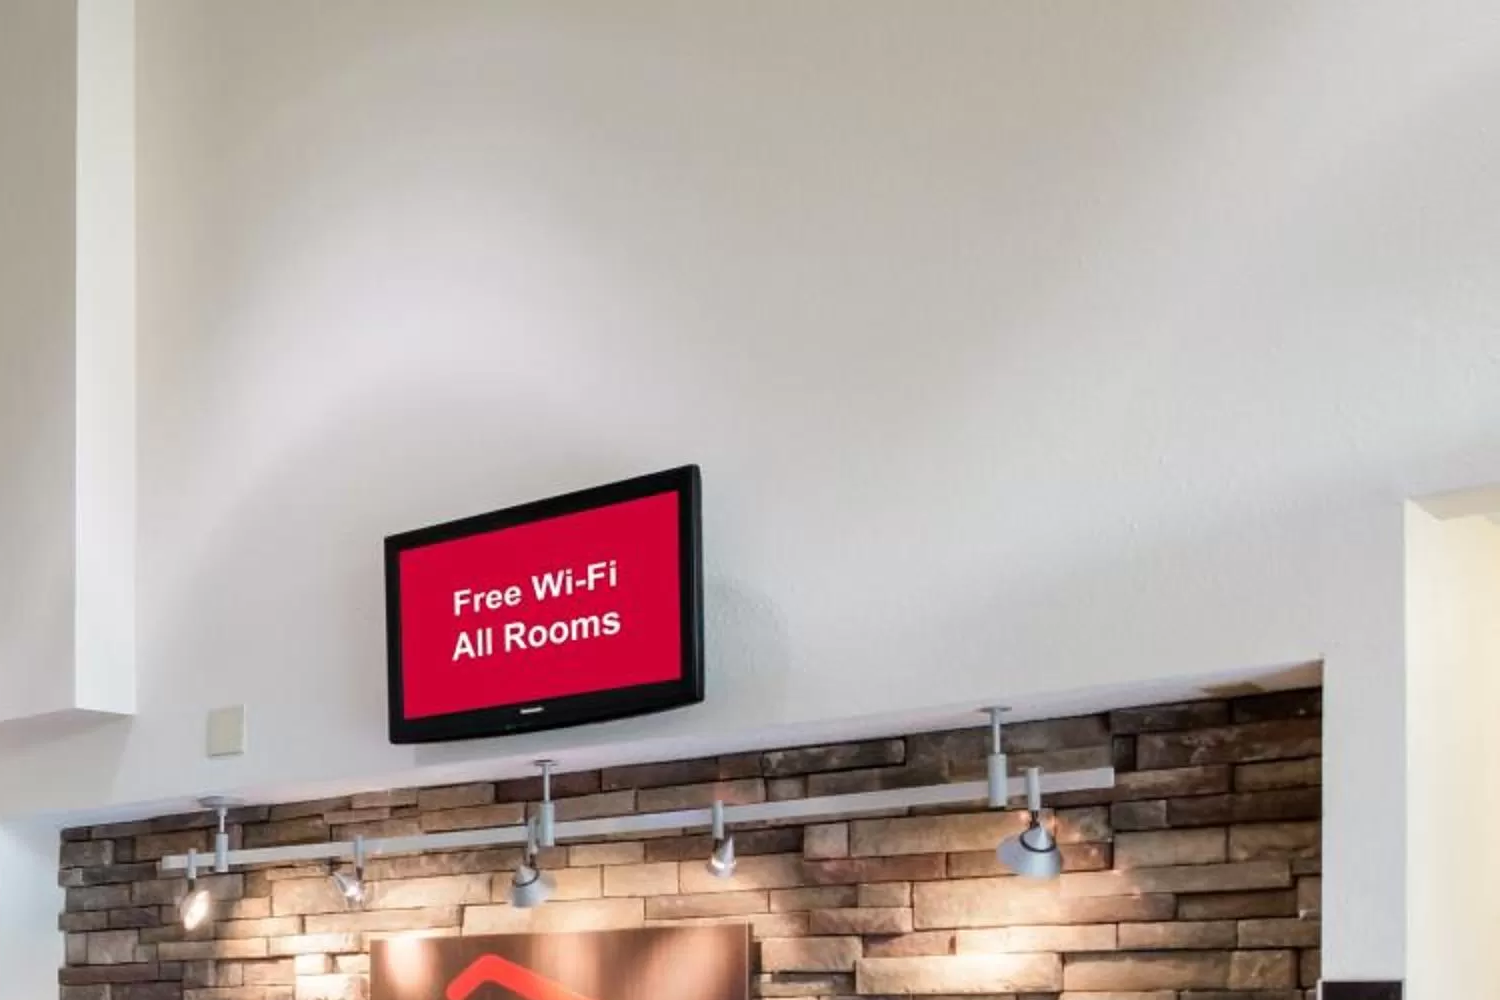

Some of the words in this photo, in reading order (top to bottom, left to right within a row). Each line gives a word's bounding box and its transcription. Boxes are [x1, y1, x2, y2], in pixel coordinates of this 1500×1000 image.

[453, 585, 522, 617] Free
[531, 560, 618, 601] Wi-Fi
[452, 627, 493, 661] All
[504, 611, 621, 652] Rooms
